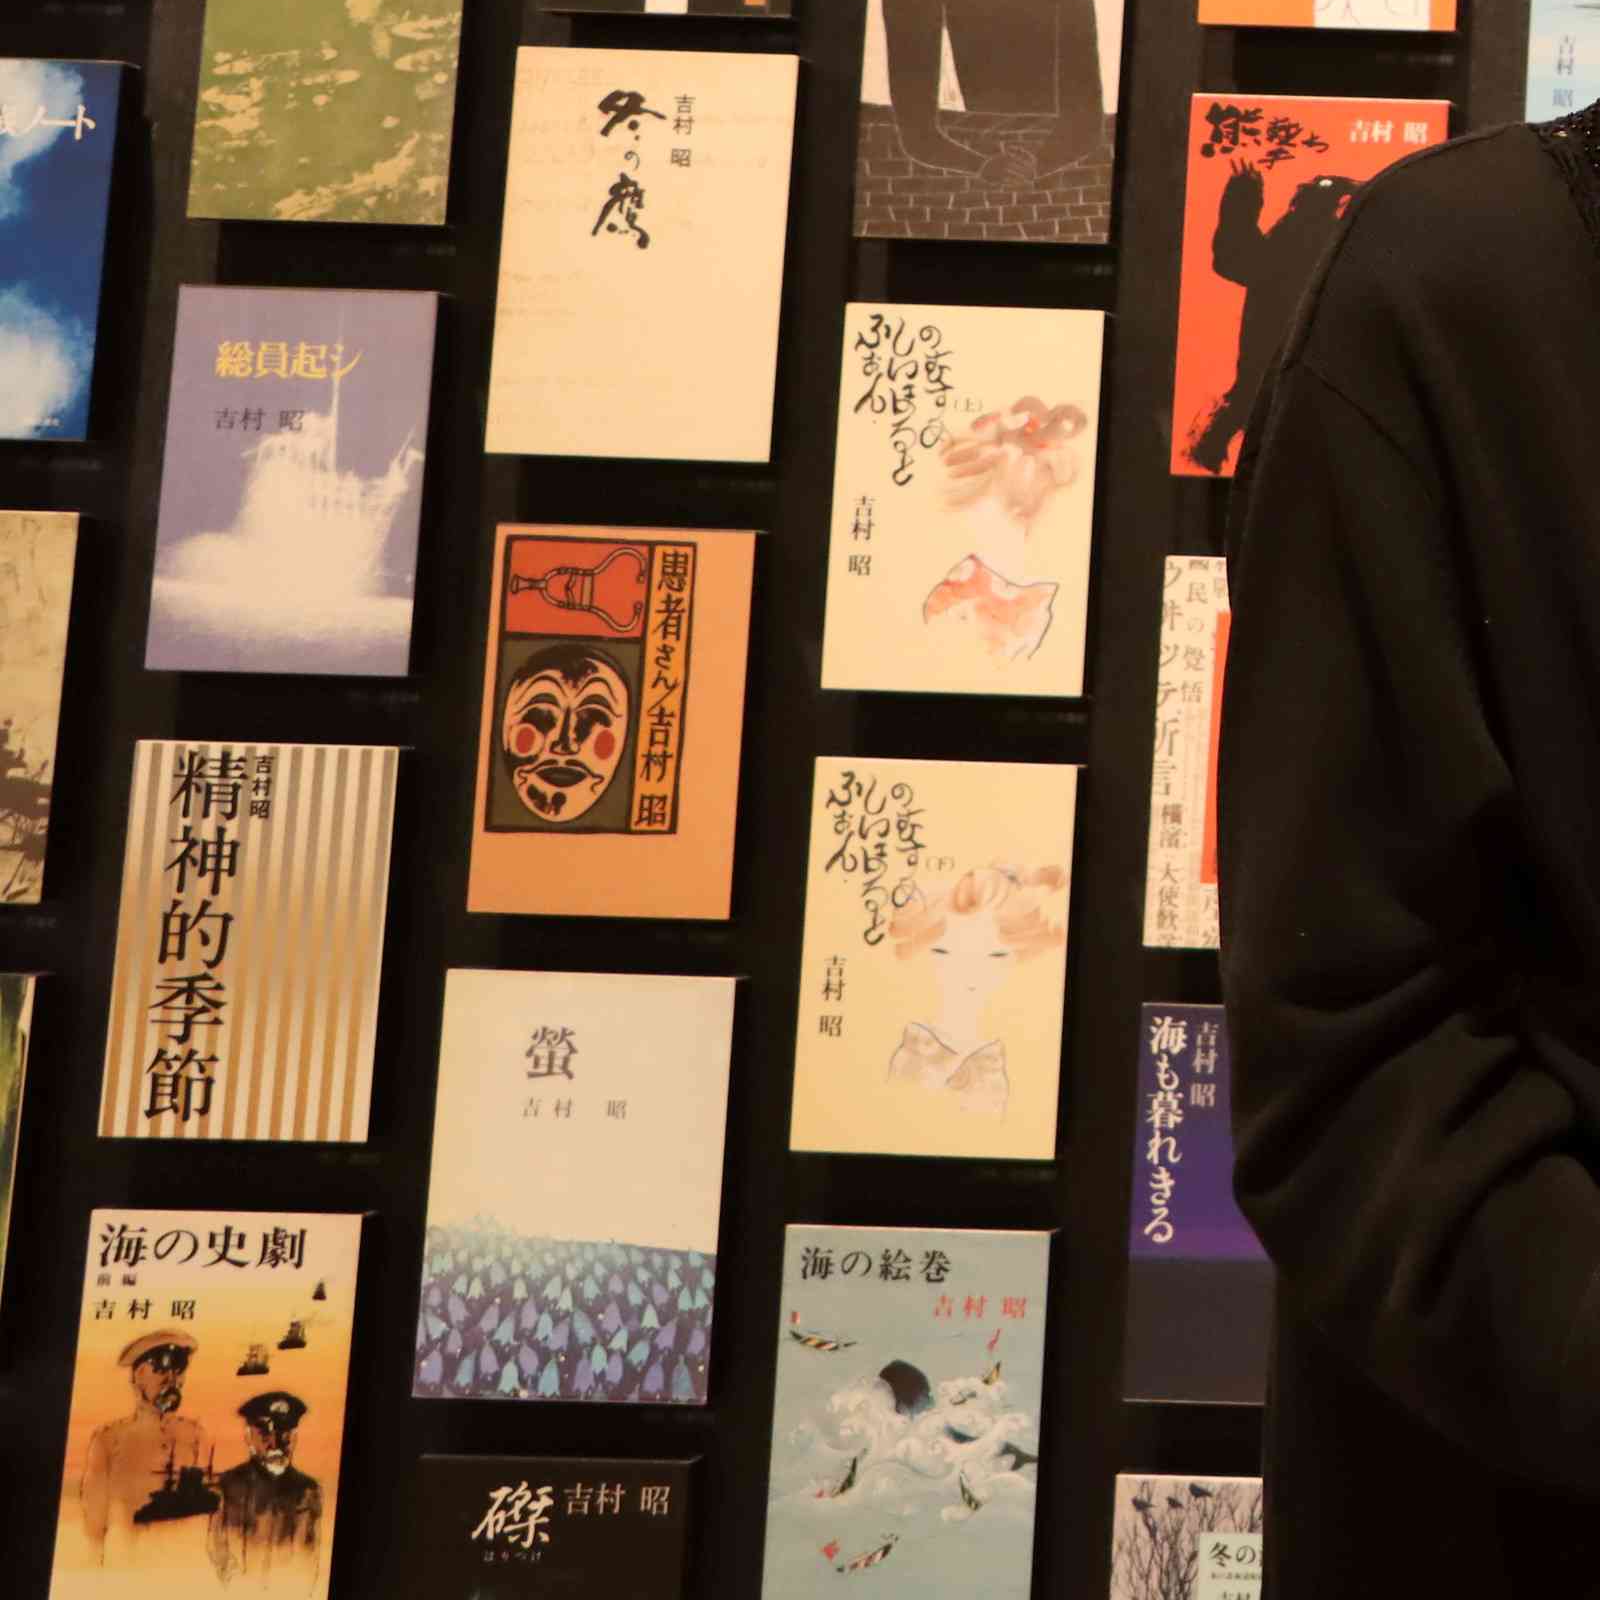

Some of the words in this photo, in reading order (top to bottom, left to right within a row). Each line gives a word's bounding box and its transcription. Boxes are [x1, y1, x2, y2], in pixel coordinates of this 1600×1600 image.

[671, 96, 695, 168] 吉村昭
[1350, 120, 1429, 145] 吉村昭
[214, 342, 363, 380] 総員起シ
[214, 408, 305, 433] 吉村昭
[849, 496, 874, 576] 吉村昭
[250, 755, 274, 820] 吉村昭
[144, 749, 249, 1123] 精神的季節
[818, 956, 847, 1037] 吉村昭
[1190, 1022, 1219, 1106] 吉村昭
[522, 1099, 628, 1119] 吉村昭
[1145, 1016, 1187, 1244] 海も暮れきる
[100, 1223, 307, 1269] 海の史劇
[801, 1248, 952, 1284] 海の絵巻
[94, 1299, 196, 1321] 吉村昭
[933, 1296, 1027, 1320] 吉村昭
[565, 1482, 670, 1517] 吉村昭
[1208, 1541, 1262, 1569] 冬の
